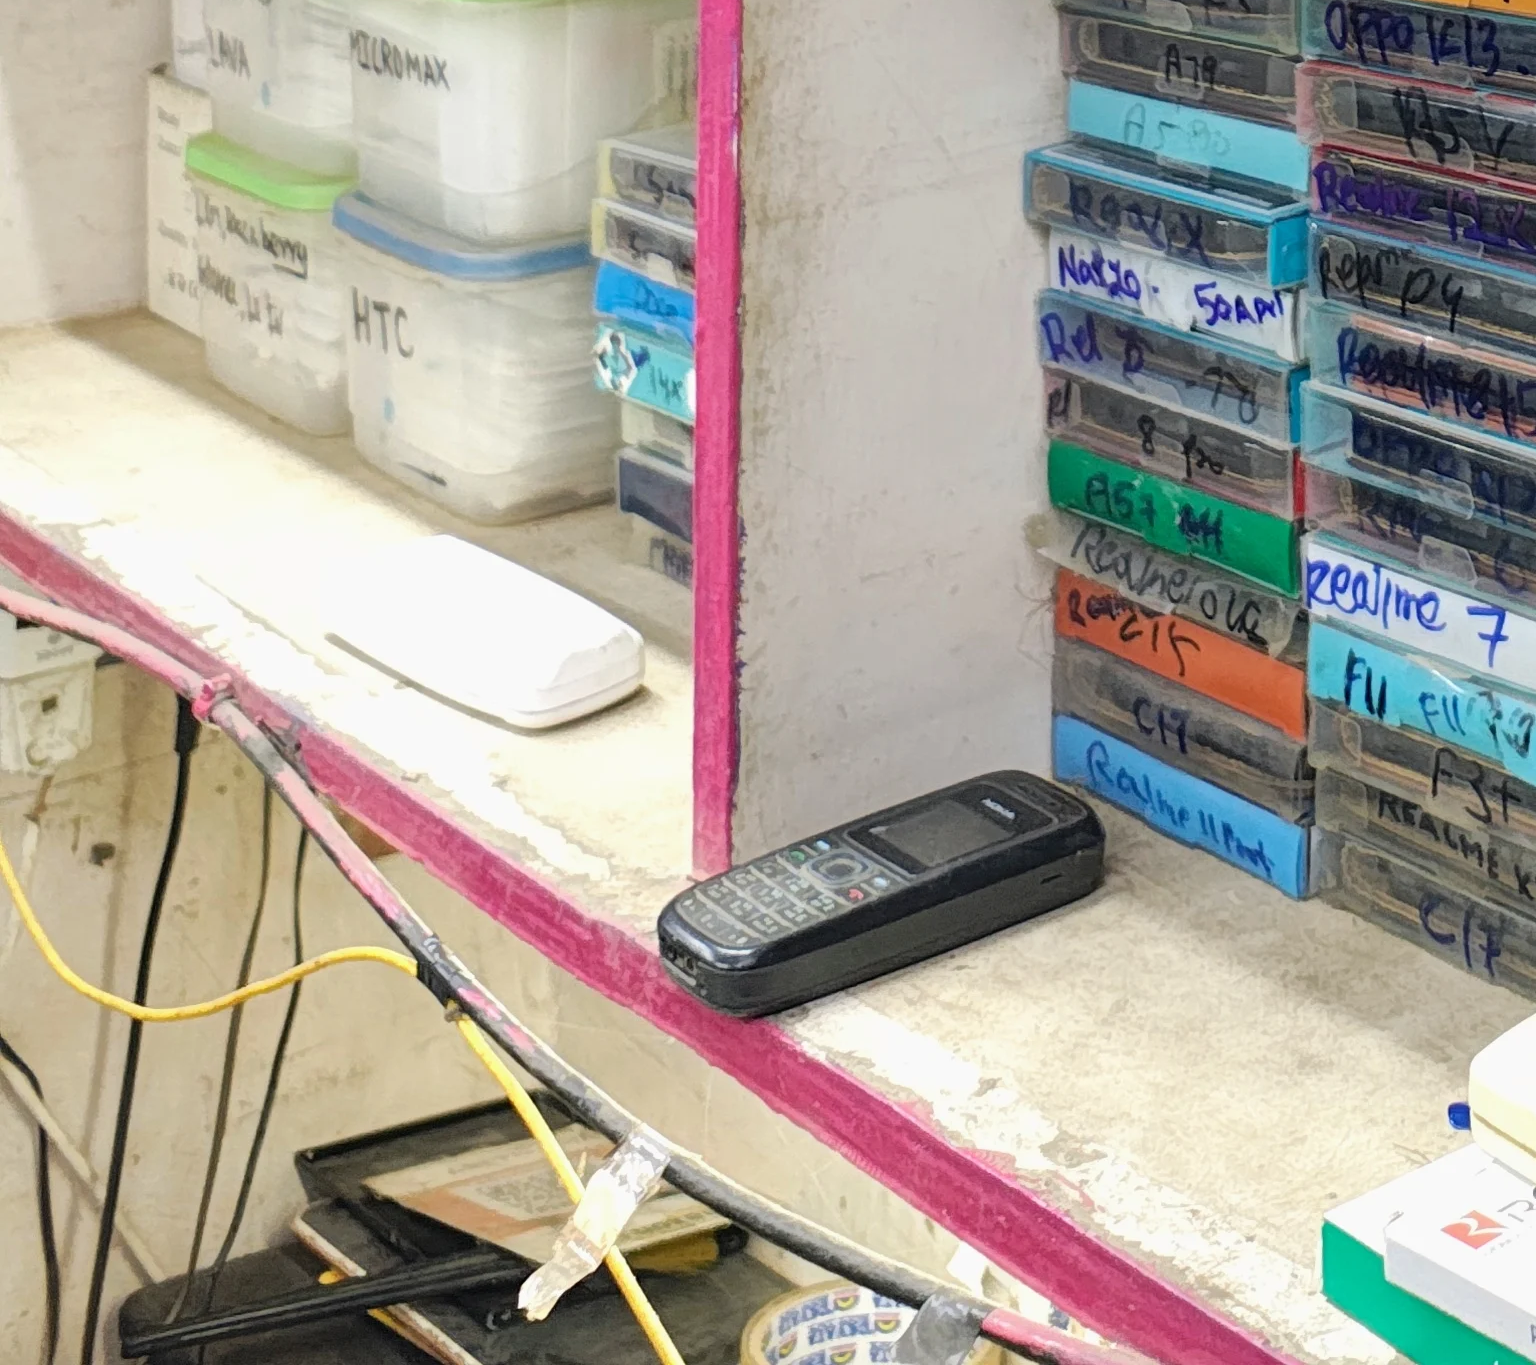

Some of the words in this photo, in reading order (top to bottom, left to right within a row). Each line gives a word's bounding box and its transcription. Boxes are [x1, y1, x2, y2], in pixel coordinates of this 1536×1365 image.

[348, 26, 451, 91] MICROMAX
[351, 287, 415, 359] HTC
[1467, 604, 1510, 668] 7
